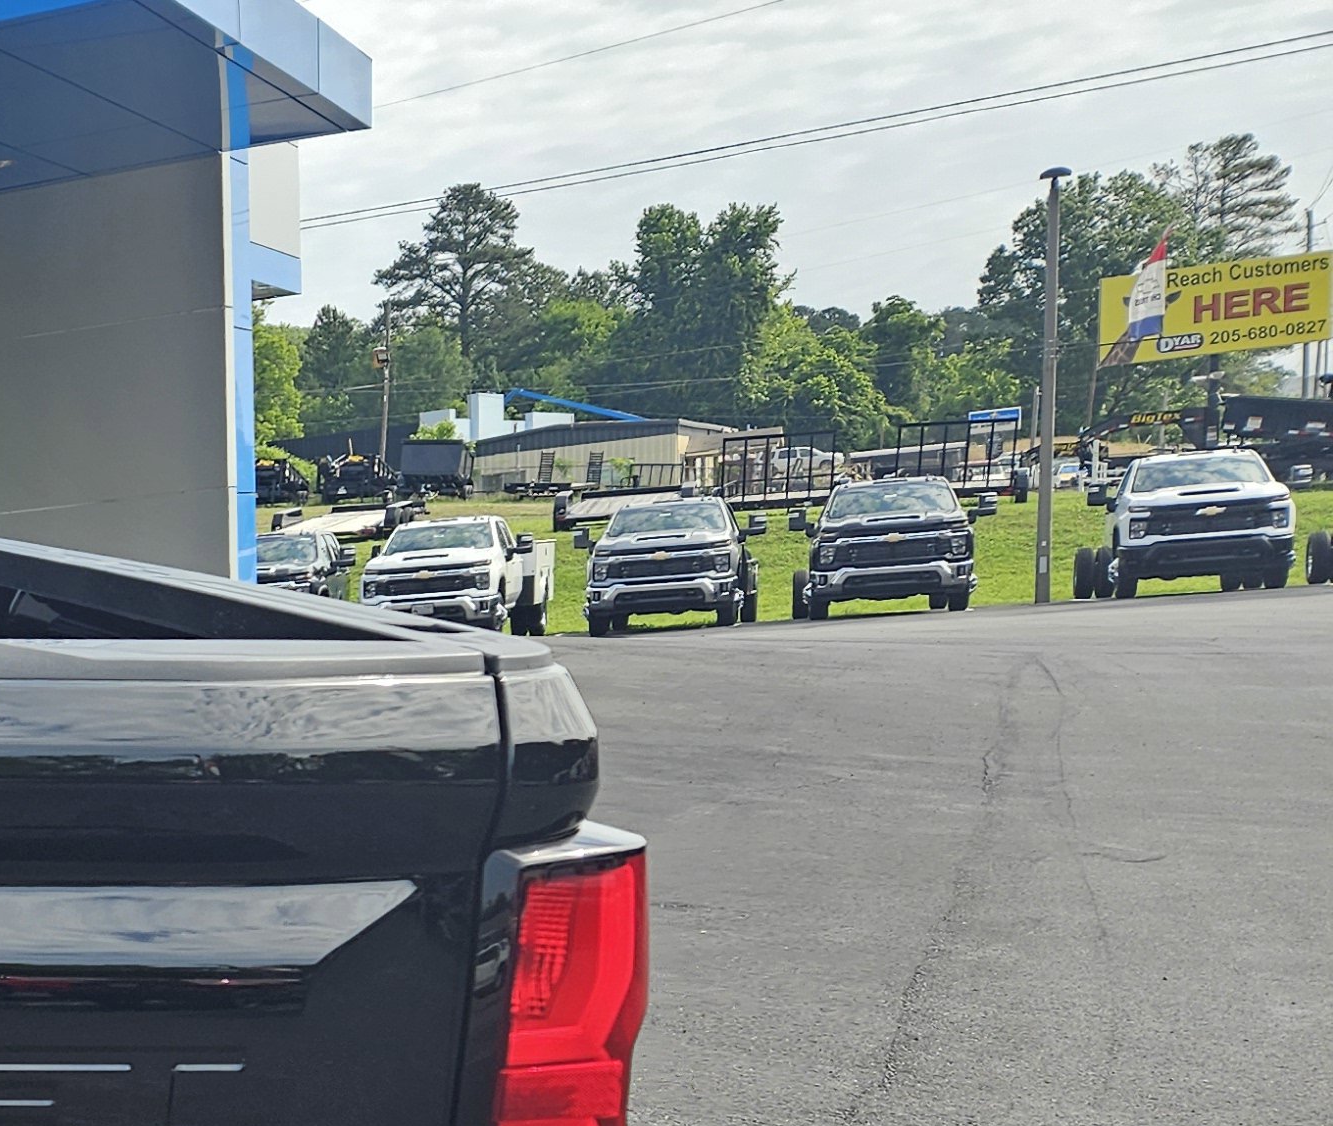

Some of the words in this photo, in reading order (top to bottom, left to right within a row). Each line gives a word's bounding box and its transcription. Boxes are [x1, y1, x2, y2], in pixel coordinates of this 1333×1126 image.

[1166, 264, 1222, 289] Reach
[1229, 256, 1330, 281] Customers
[1193, 282, 1311, 324] HERE
[1159, 334, 1203, 352] DYAR
[1210, 319, 1327, 345] 205-680-0827
